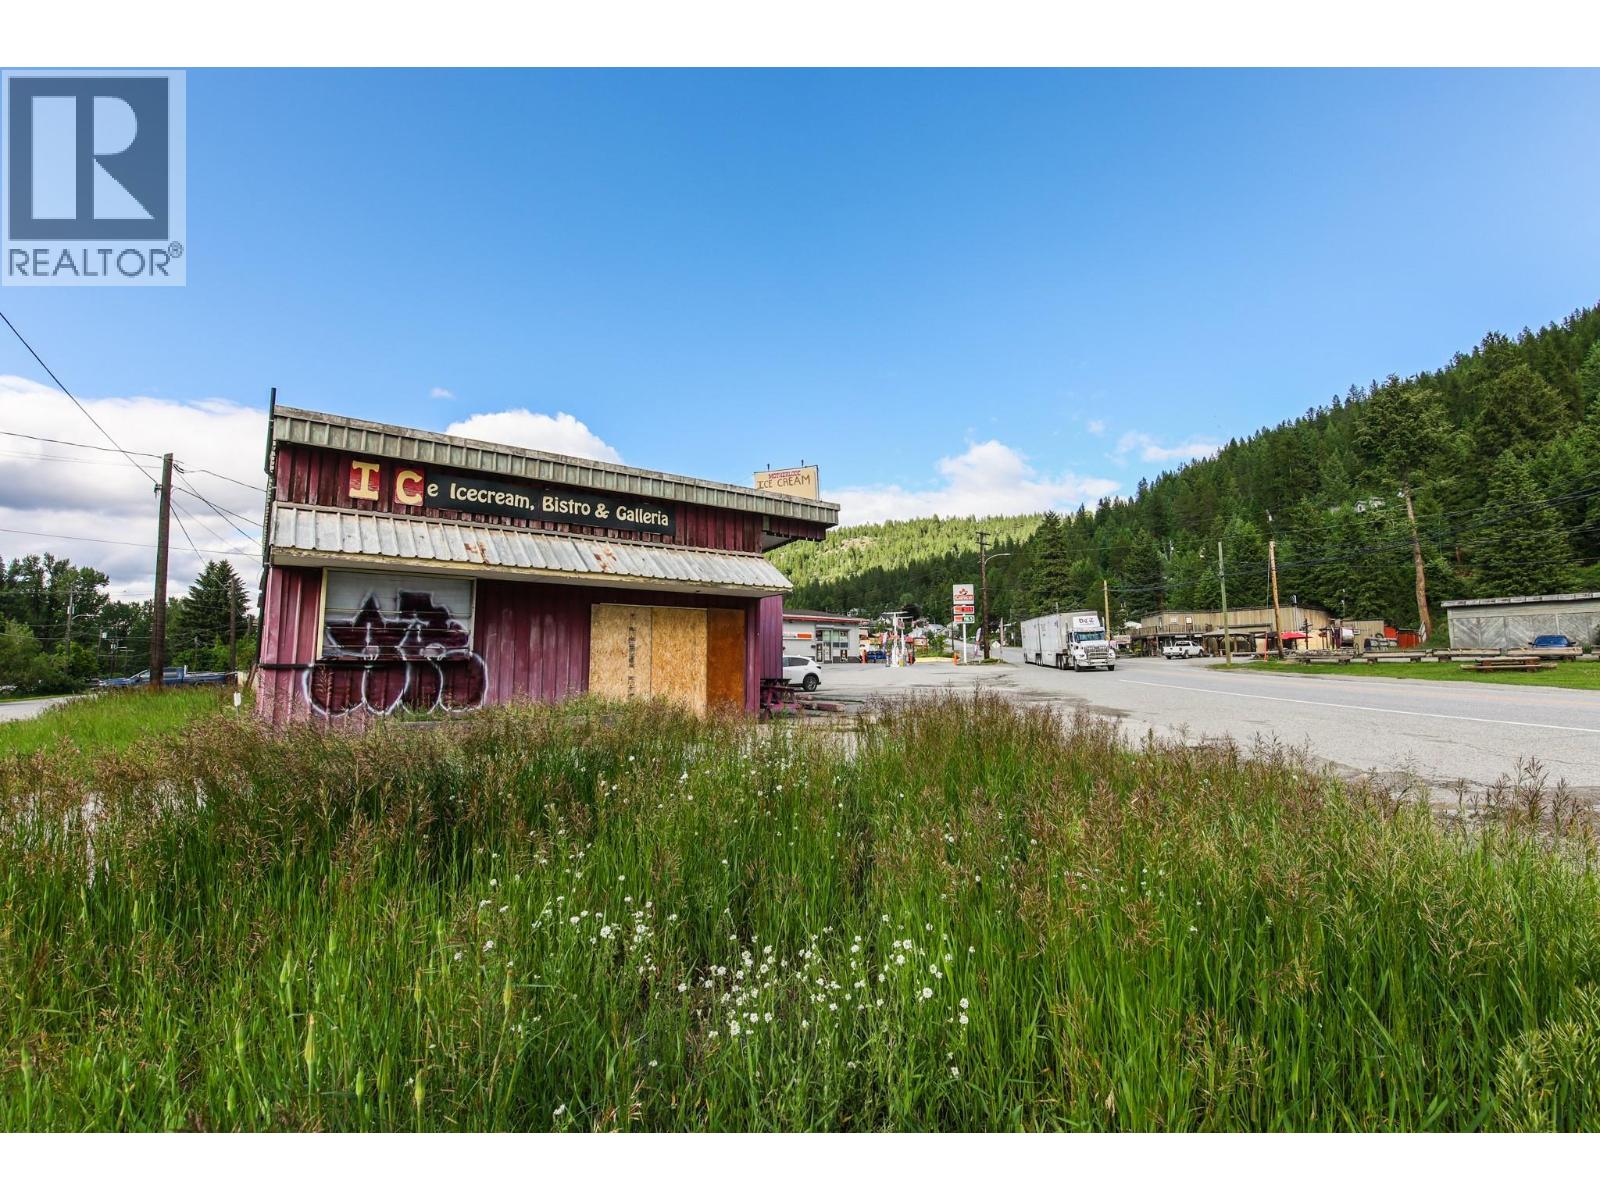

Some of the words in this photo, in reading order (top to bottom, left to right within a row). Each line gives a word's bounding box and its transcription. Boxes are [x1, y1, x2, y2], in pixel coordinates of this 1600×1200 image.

[757, 480, 773, 489] ICE
[777, 475, 811, 488] CREAM
[450, 483, 535, 511] Icecream,
[542, 496, 591, 516] Bistro
[594, 503, 610, 519] &
[616, 506, 669, 526] Galleria
